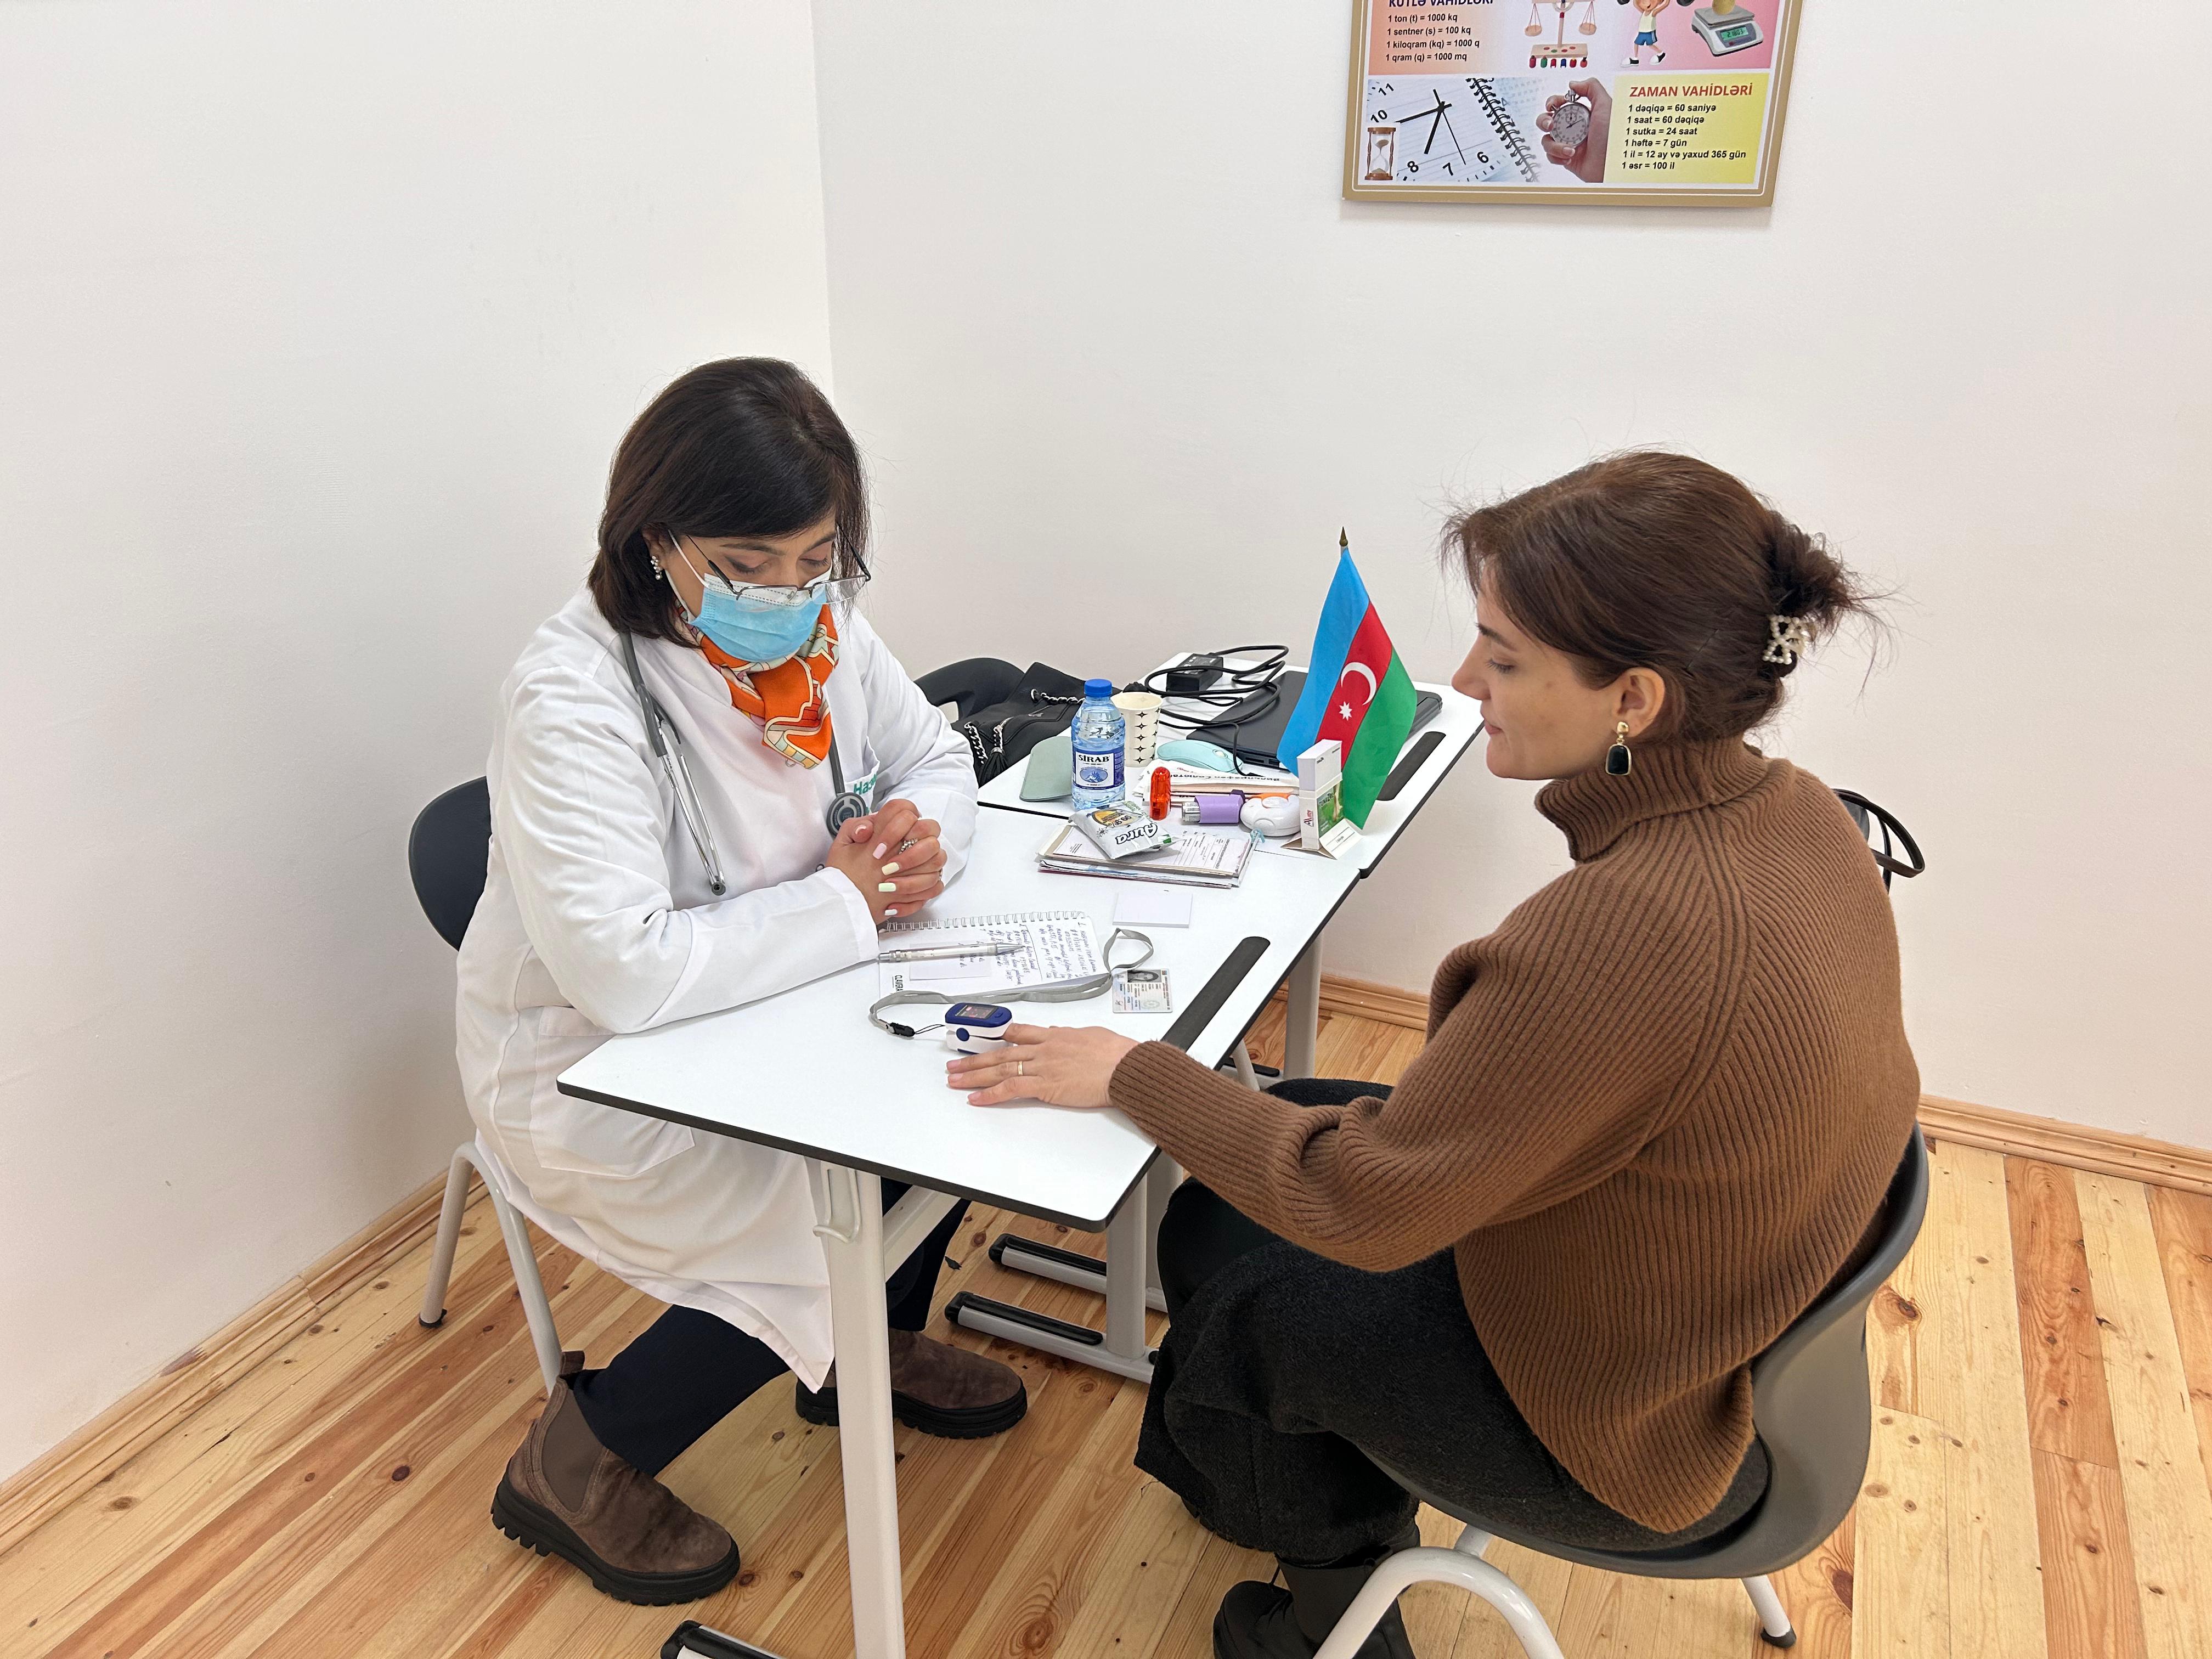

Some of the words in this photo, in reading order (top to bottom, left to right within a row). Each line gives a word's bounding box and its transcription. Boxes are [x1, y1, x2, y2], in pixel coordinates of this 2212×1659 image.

[1448, 13, 1457, 22] kq
[1426, 27, 1435, 36] (s)
[1462, 26, 1470, 35] kq
[1393, 41, 1426, 49] kiloqram
[1430, 40, 1444, 49] (kq)
[1414, 53, 1424, 62] (q)
[1378, 82, 1393, 95] 11
[1630, 86, 1678, 97] ZAMAN
[1683, 83, 1752, 96] VAHİDLƏRİ
[1636, 104, 1664, 114] dəqiqə
[1688, 104, 1716, 113] saniyə
[1371, 110, 1387, 122] 10
[1675, 116, 1704, 125] dəqiqə
[1671, 139, 1686, 148] gün
[1477, 152, 1488, 163] 6
[1682, 150, 1709, 160] yaxud
[1729, 150, 1746, 160] gün
[1408, 161, 1418, 172] 8
[1443, 162, 1453, 176] 7
[1115, 823, 1158, 844] Aura
